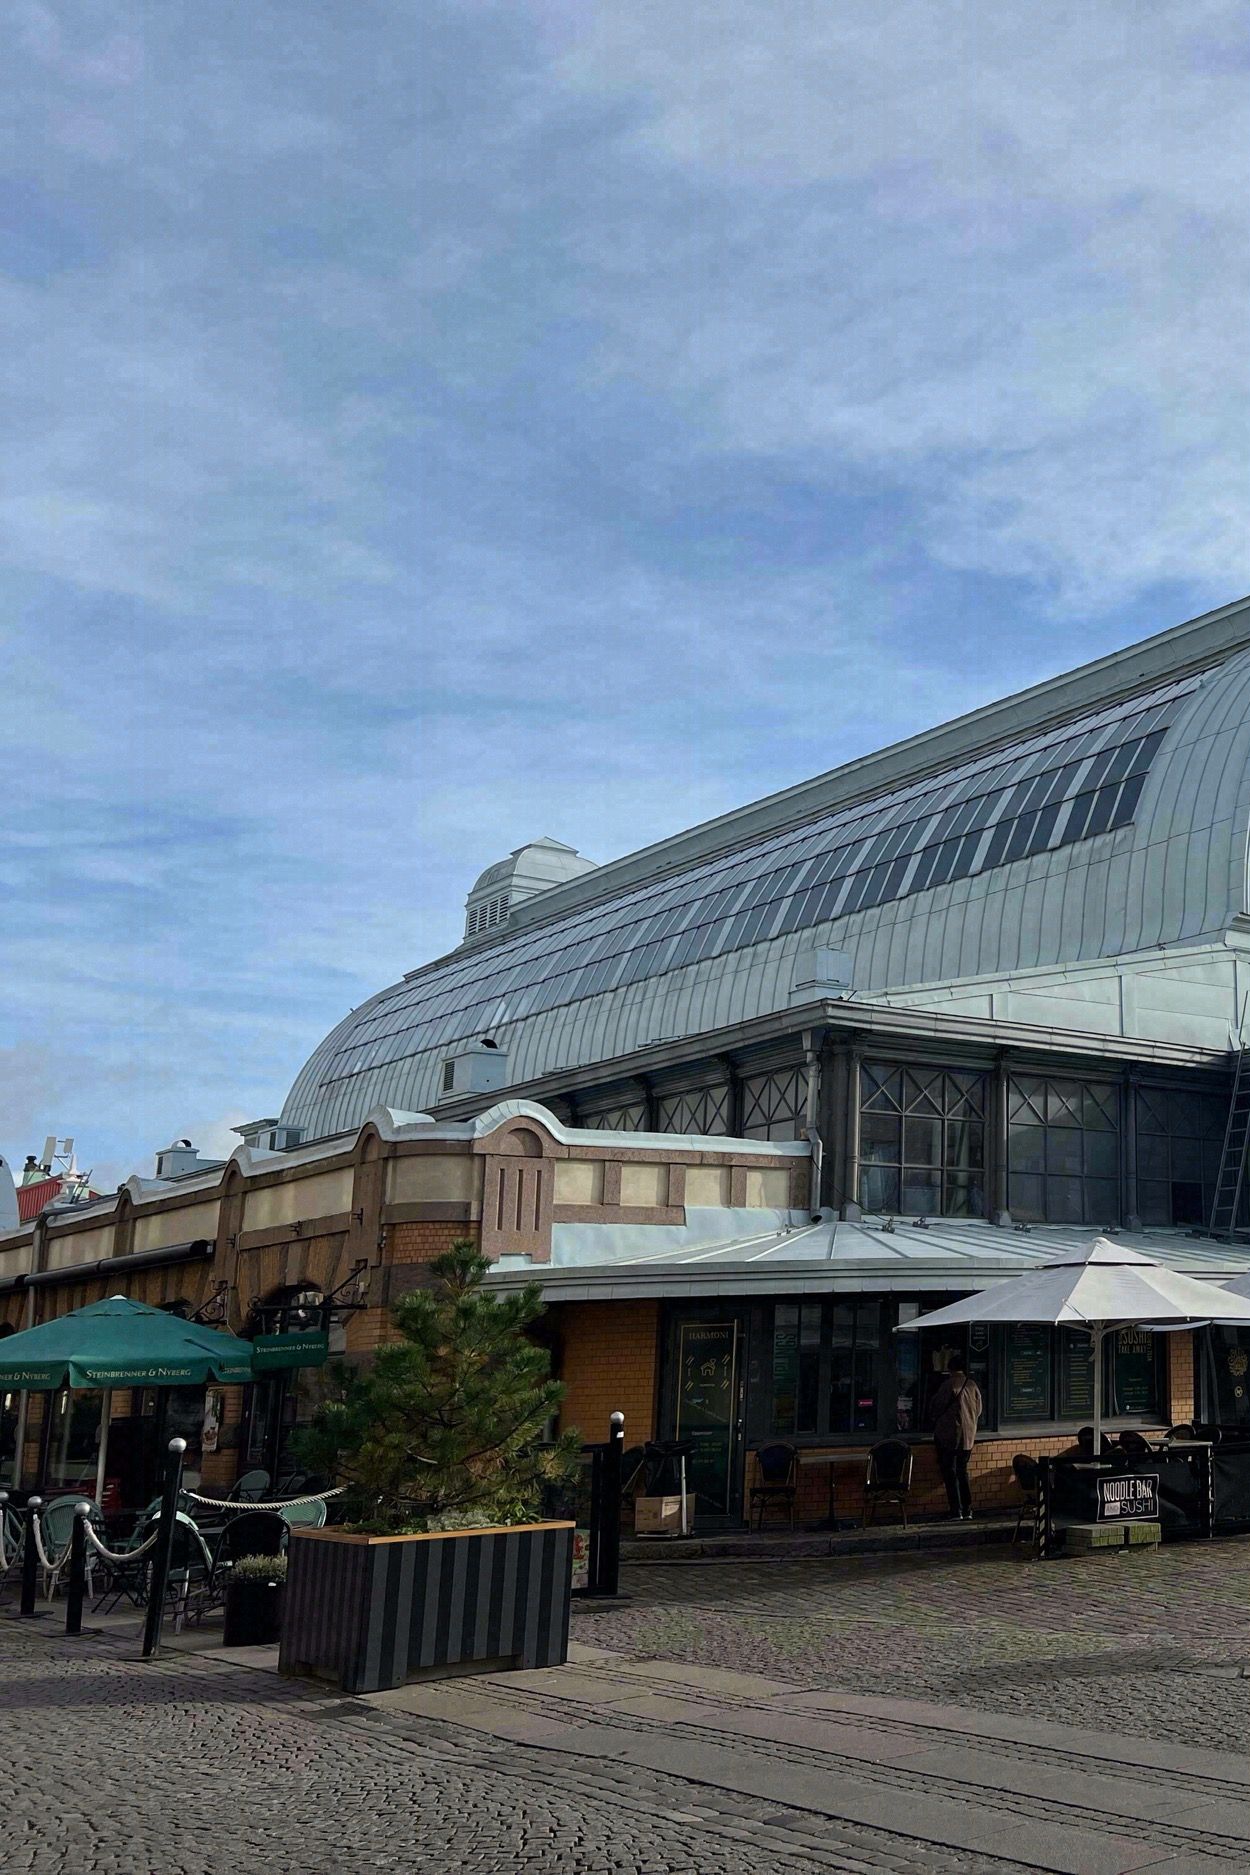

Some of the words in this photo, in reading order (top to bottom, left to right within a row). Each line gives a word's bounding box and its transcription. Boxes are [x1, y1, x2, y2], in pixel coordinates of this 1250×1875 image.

[689, 1331, 729, 1341] HARMONI
[1122, 1327, 1147, 1345] SUSHI
[13, 1372, 21, 1380] &
[21, 1371, 51, 1380] NYBERG
[86, 1369, 146, 1379] STEINBRENNER
[148, 1368, 156, 1377] &
[157, 1367, 192, 1377] NYBERG
[1103, 1480, 1135, 1502] NOODLE
[1136, 1479, 1153, 1499] BAR
[1121, 1499, 1154, 1514] SUSHI
